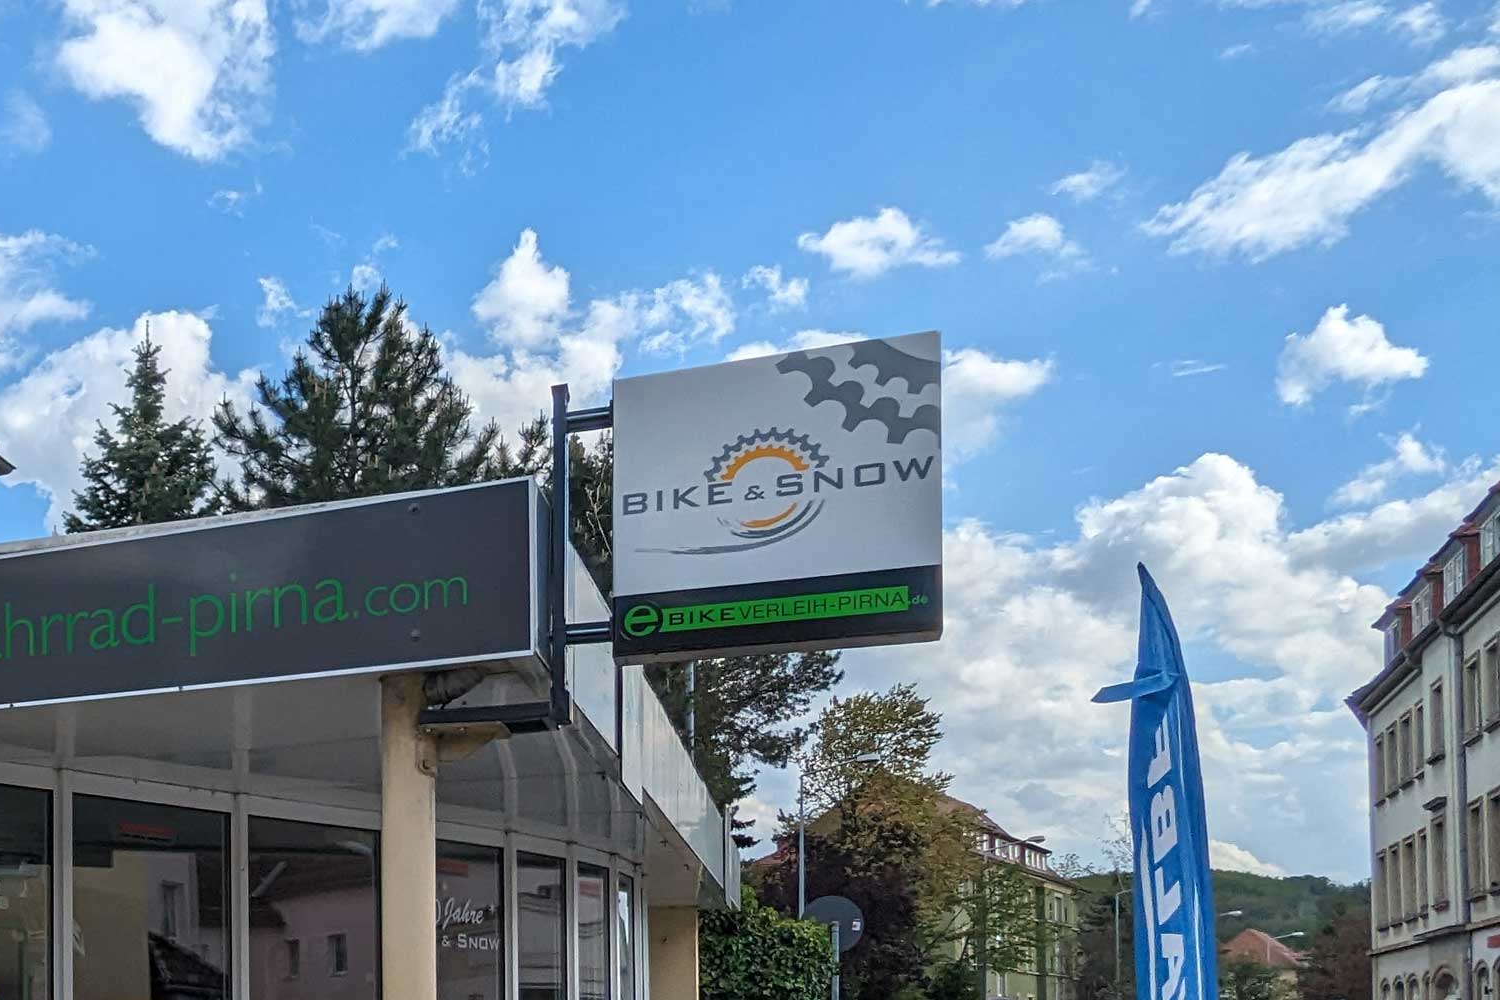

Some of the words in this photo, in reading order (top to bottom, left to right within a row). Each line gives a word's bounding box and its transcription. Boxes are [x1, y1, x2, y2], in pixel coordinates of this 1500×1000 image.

[622, 481, 733, 516] BIKE
[743, 484, 766, 502] &
[775, 455, 935, 500] SNOW
[442, 896, 485, 931] Jahre
[441, 935, 451, 947] &
